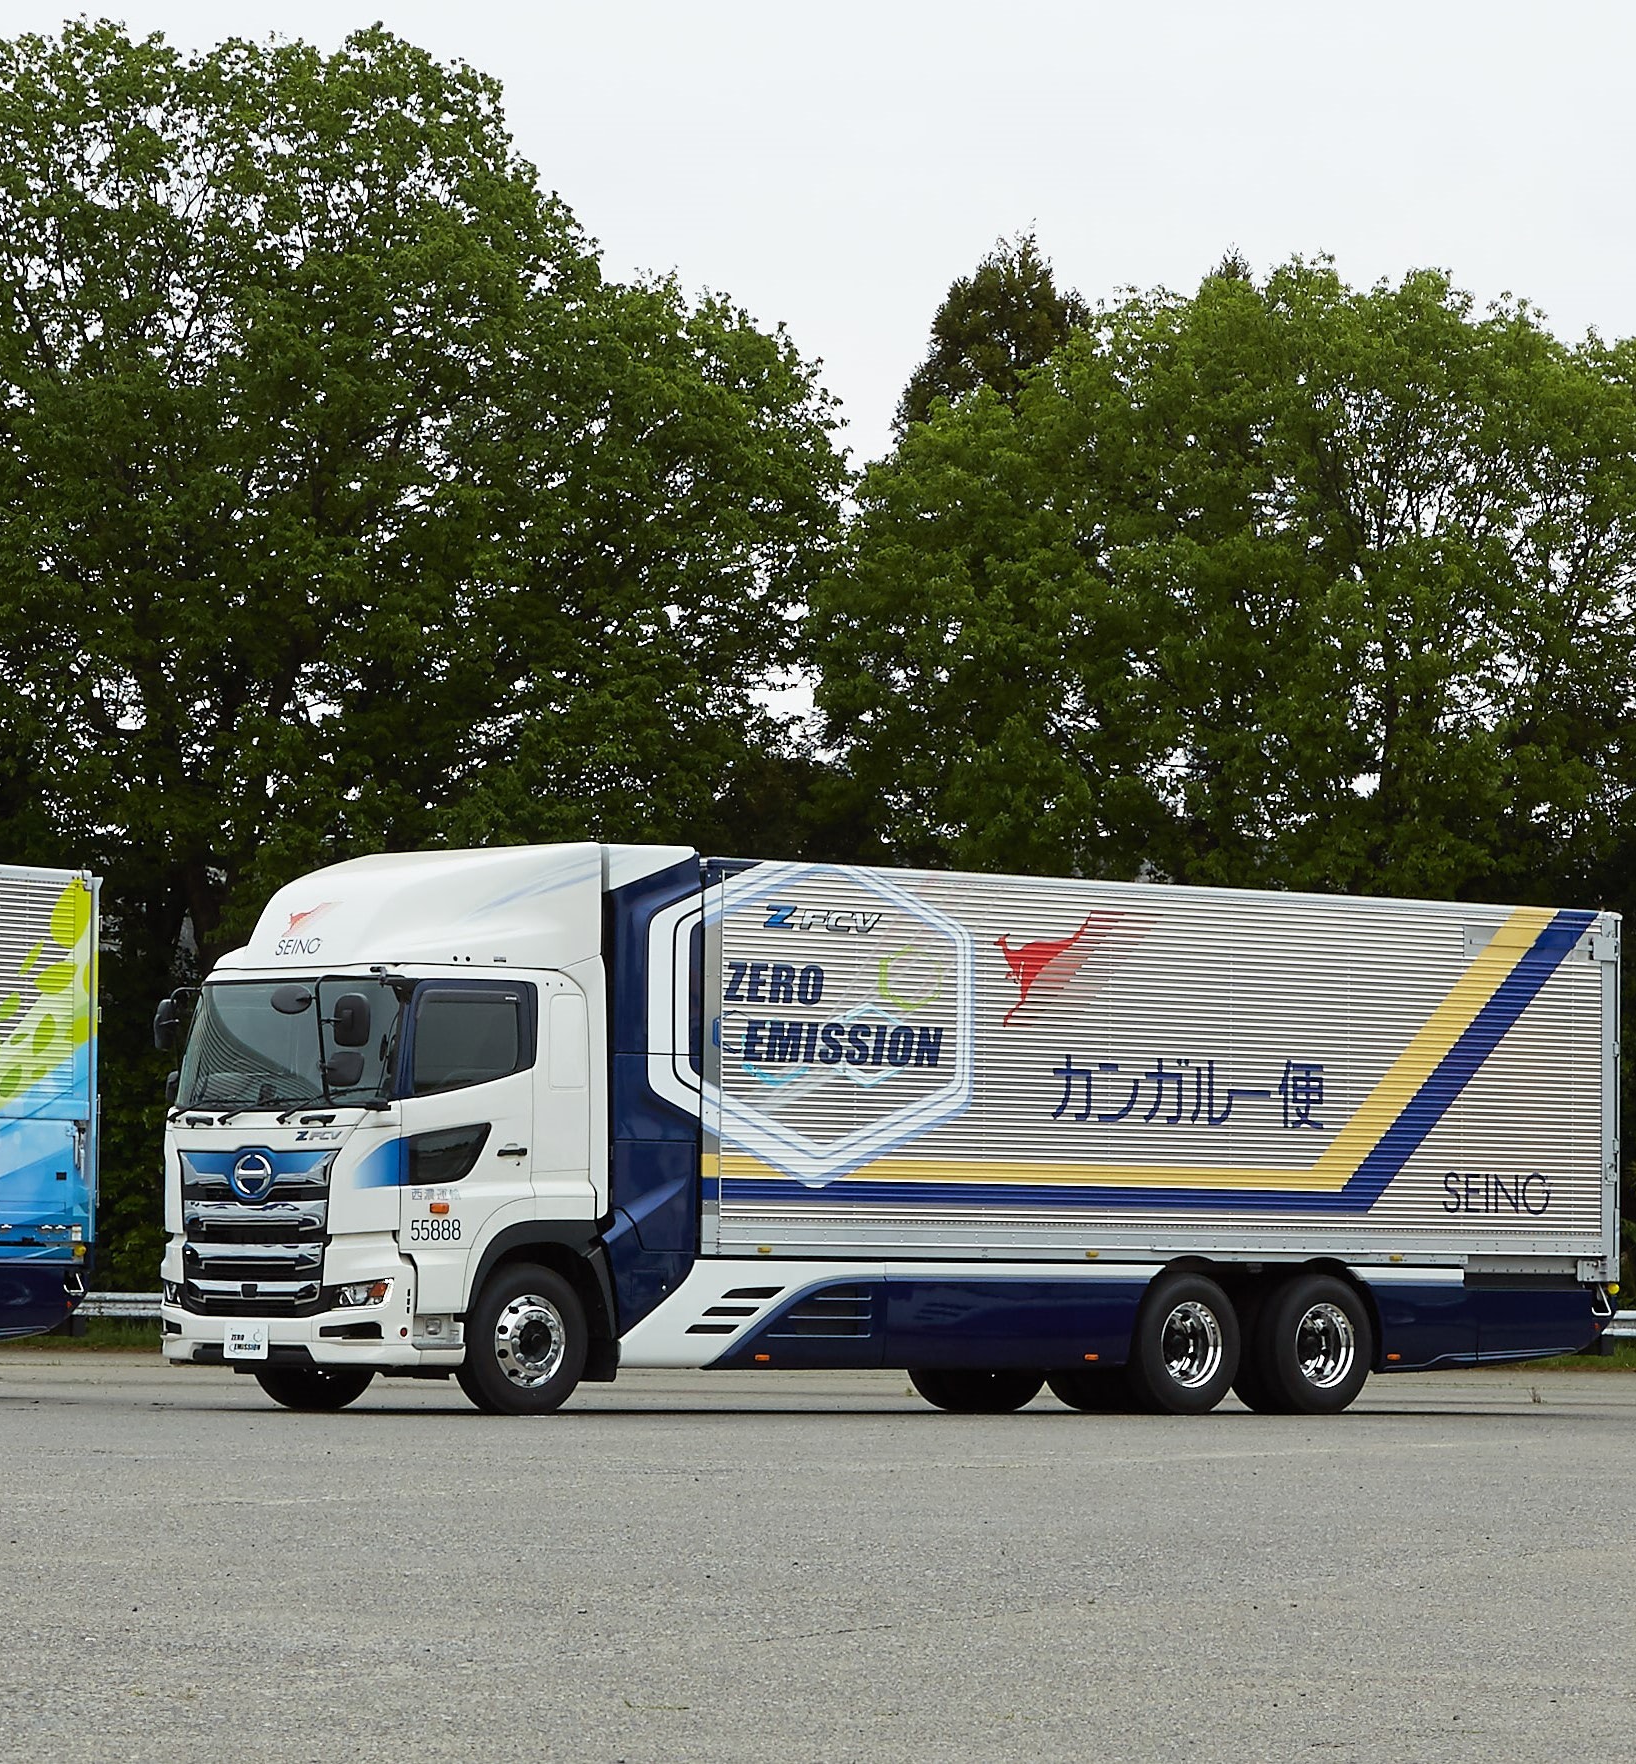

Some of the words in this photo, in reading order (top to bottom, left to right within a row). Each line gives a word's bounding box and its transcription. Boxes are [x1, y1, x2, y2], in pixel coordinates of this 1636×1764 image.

[275, 937, 323, 956] SEINO
[723, 961, 824, 1005] ZERO
[743, 1019, 943, 1067] EMISSION
[1051, 1054, 1324, 1128] カンガルー便
[1443, 1171, 1553, 1216] SEINO
[411, 1219, 461, 1241] 55888
